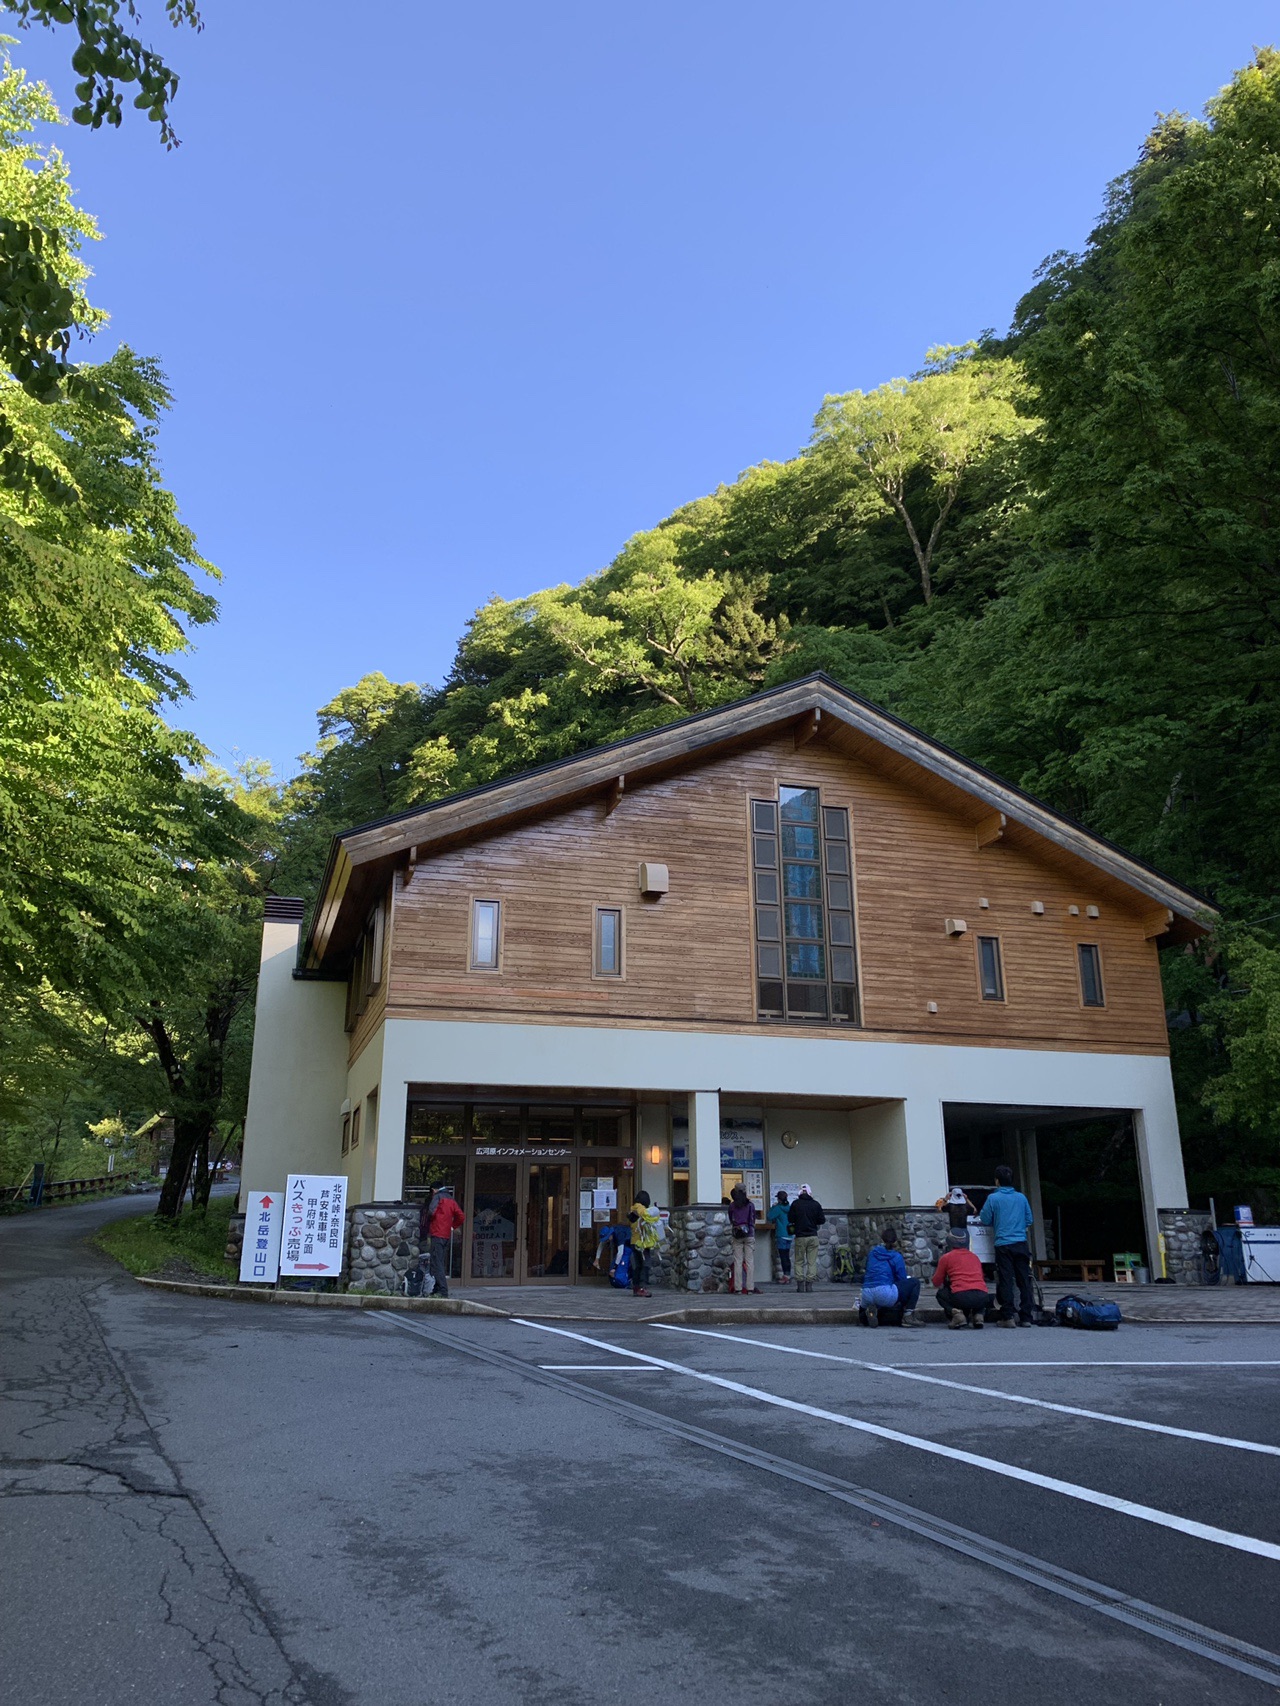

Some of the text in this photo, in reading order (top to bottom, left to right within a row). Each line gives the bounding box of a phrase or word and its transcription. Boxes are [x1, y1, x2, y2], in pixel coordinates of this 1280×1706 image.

[475, 1147, 572, 1156] 広河原インフォメーションセンター
[253, 1211, 271, 1277] 北岳登山口
[286, 1179, 306, 1262] バスきっぷ売場
[316, 1190, 330, 1243] 芦安駐車場
[329, 1183, 342, 1249] 北沢峠・奈良田
